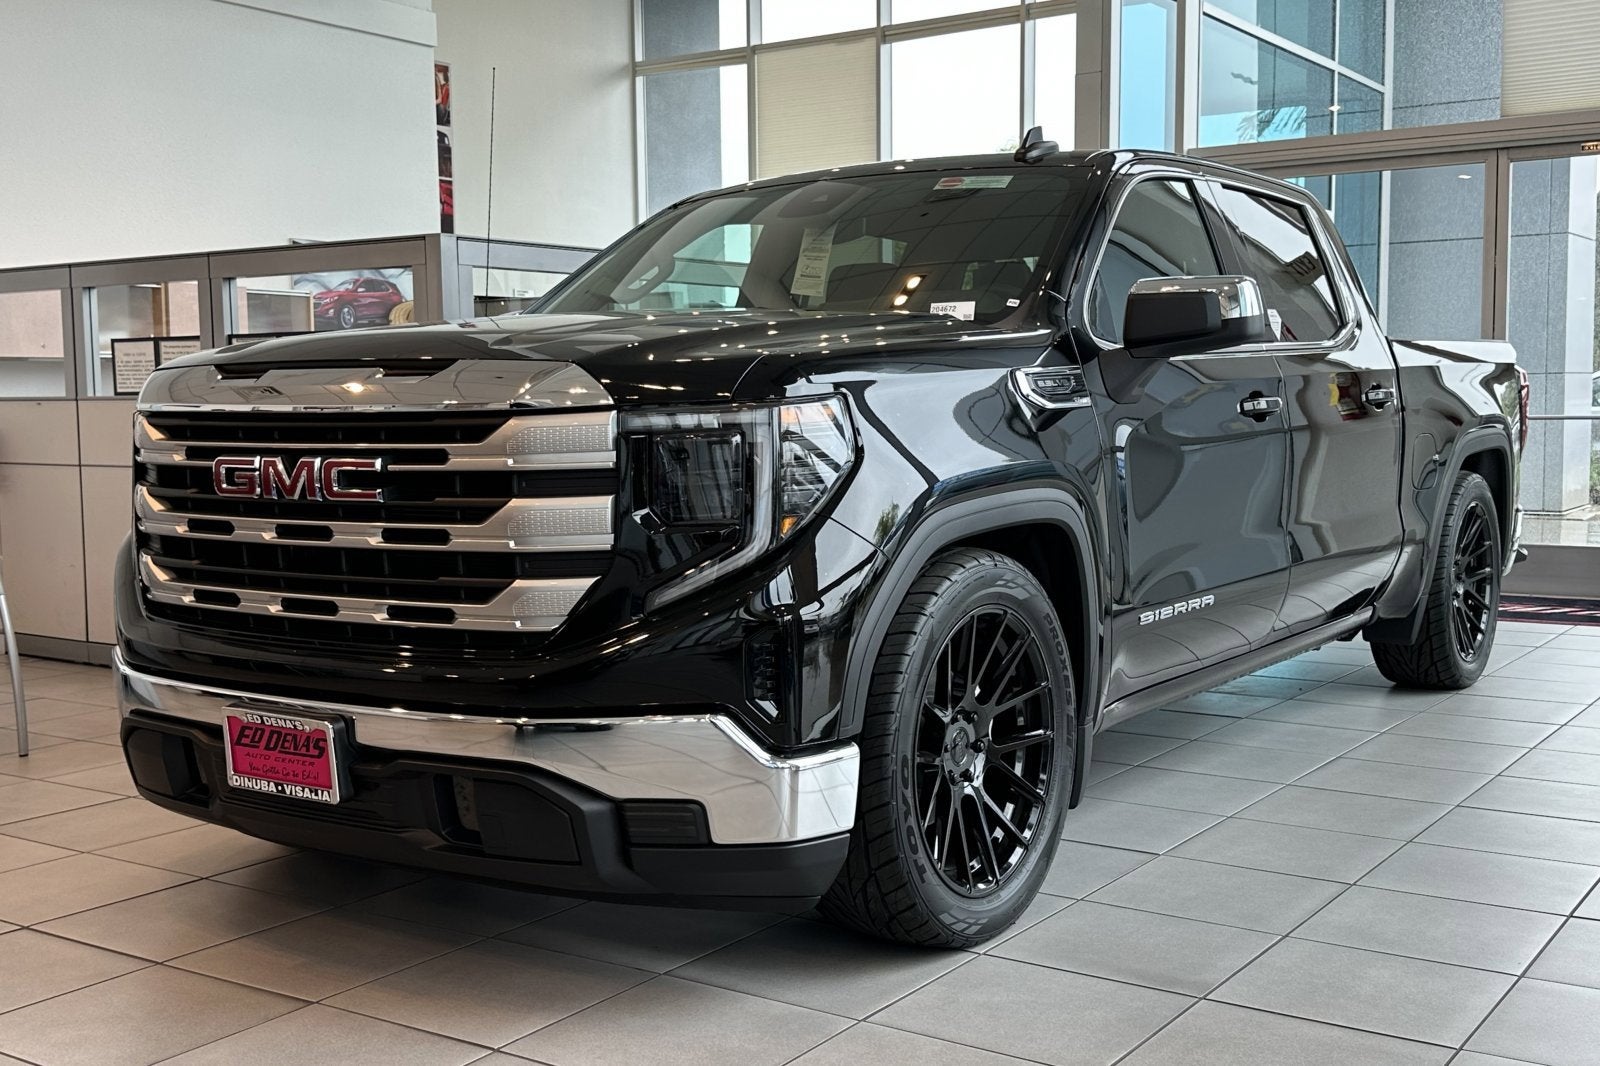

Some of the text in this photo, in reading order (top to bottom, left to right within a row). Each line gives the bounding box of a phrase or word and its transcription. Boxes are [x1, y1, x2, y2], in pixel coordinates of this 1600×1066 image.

[213, 456, 384, 502] GMC
[1139, 594, 1215, 625] SIERRA
[1042, 612, 1073, 707] PROXES
[246, 713, 304, 730] ED DENA'S
[234, 725, 328, 759] ED DENA'S
[244, 751, 316, 768] AUTO CENTER
[232, 775, 331, 801] DINUBA VISALIA
[901, 753, 928, 884] TOYO
